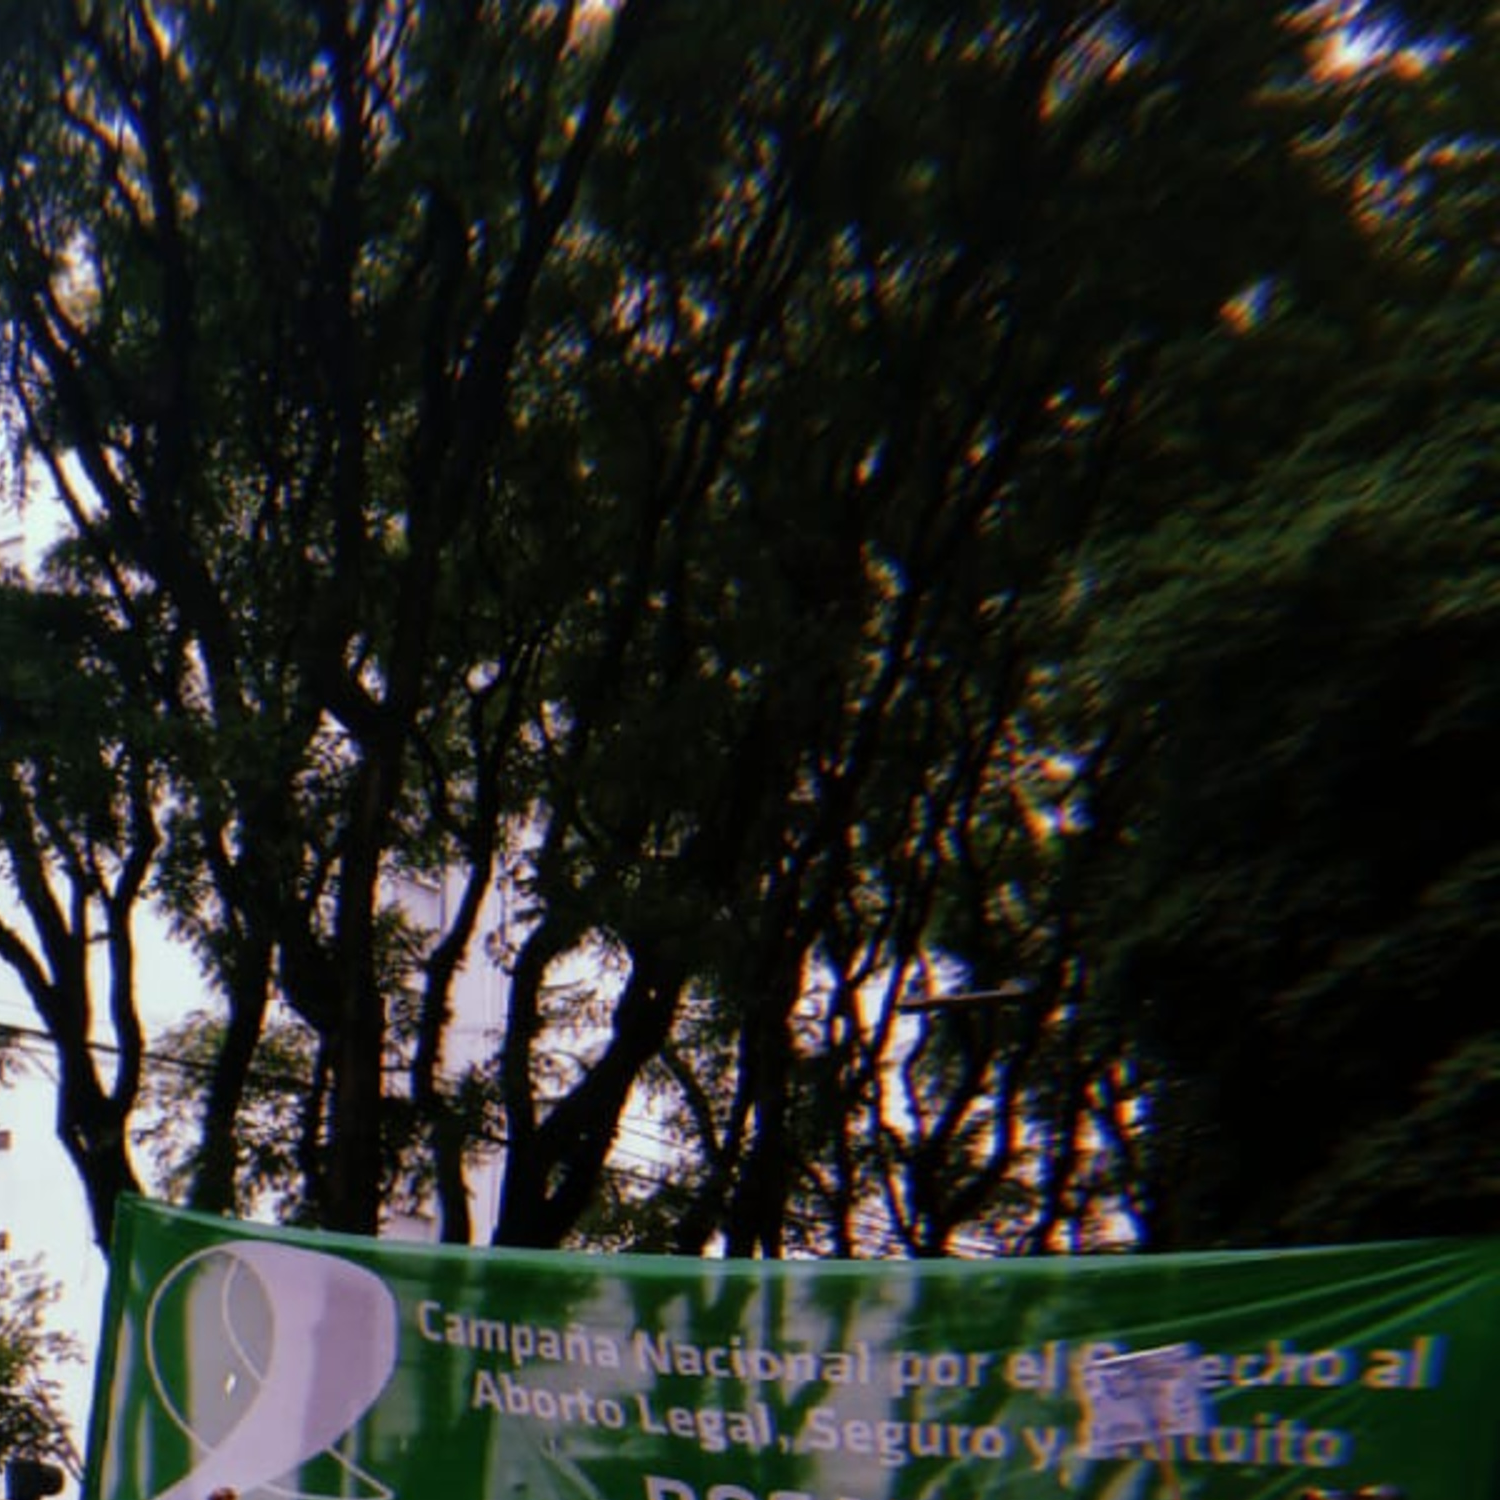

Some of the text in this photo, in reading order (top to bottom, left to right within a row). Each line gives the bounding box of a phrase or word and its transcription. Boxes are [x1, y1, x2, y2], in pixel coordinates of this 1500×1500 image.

[417, 1300, 1448, 1396] Campaña Nacional por el echo al
[471, 1369, 626, 1430] Aborto
[805, 1406, 1010, 1468] Seguro
[1021, 1426, 1066, 1473] y
